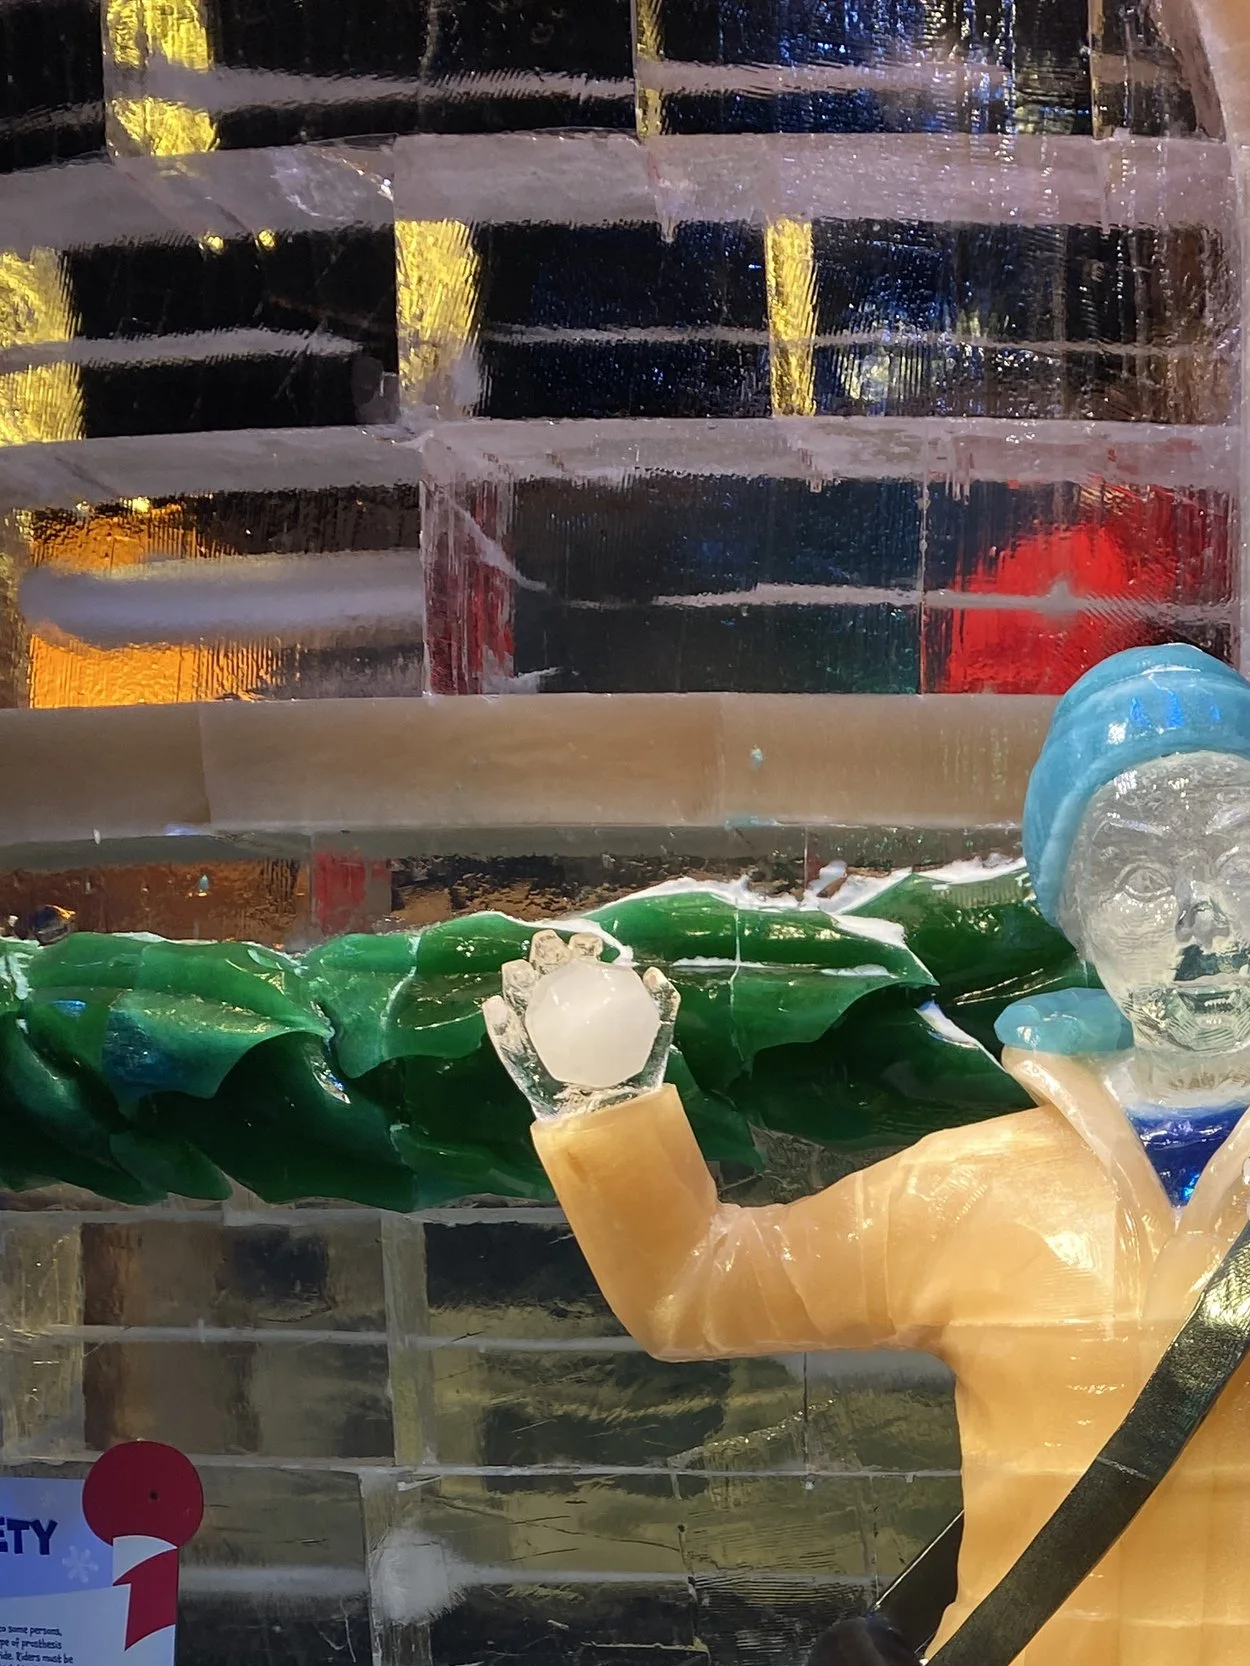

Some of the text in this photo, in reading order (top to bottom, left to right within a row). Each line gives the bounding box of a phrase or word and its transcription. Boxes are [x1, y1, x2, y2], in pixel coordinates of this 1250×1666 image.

[8, 1626, 28, 1634] some
[11, 1637, 19, 1648] of
[22, 1638, 62, 1650] prosthesis
[16, 1651, 40, 1662] Riders
[42, 1654, 61, 1663] must
[63, 1653, 73, 1664] be
